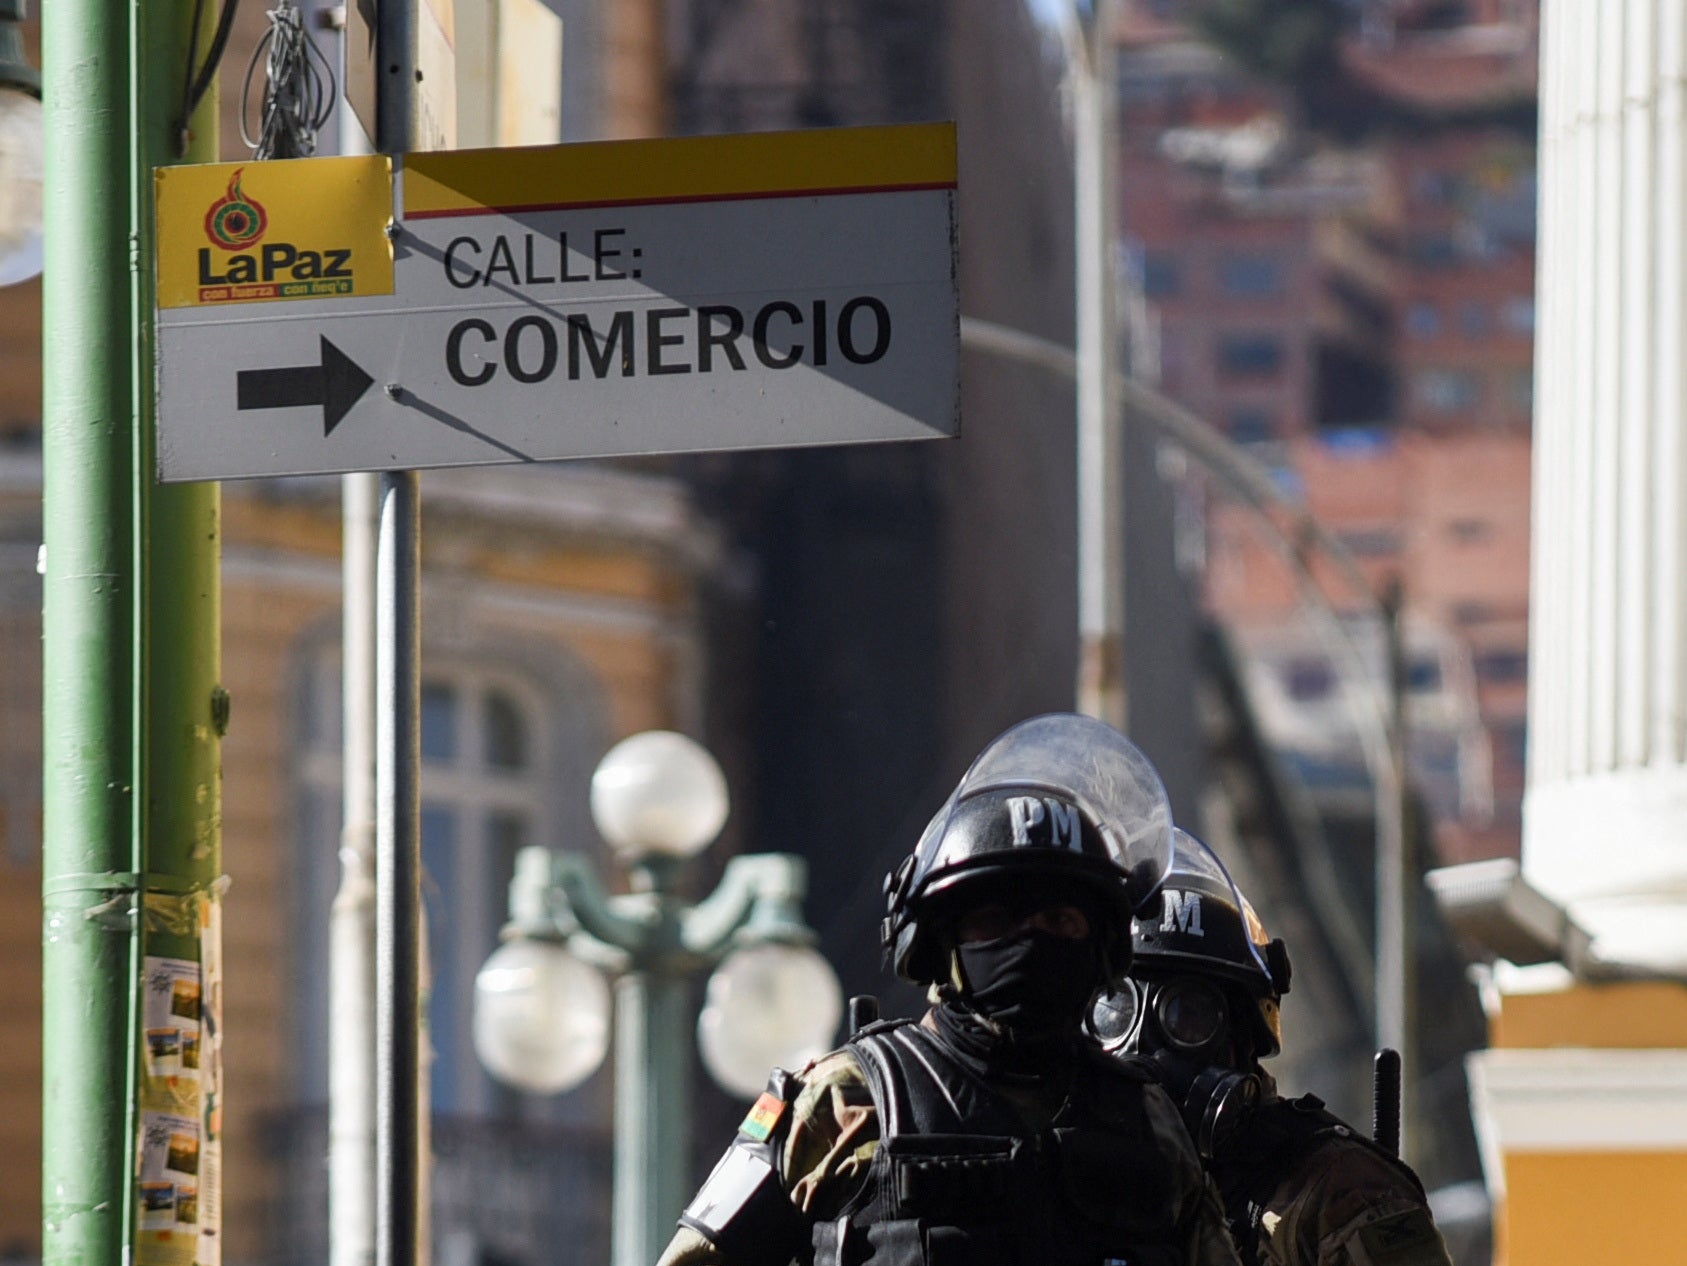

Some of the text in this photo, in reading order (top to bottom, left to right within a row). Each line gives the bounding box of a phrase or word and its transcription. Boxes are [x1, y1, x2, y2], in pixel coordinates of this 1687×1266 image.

[443, 229, 643, 289] CALLE:
[444, 294, 892, 388] COMERCIO
[1006, 796, 1084, 853] PM
